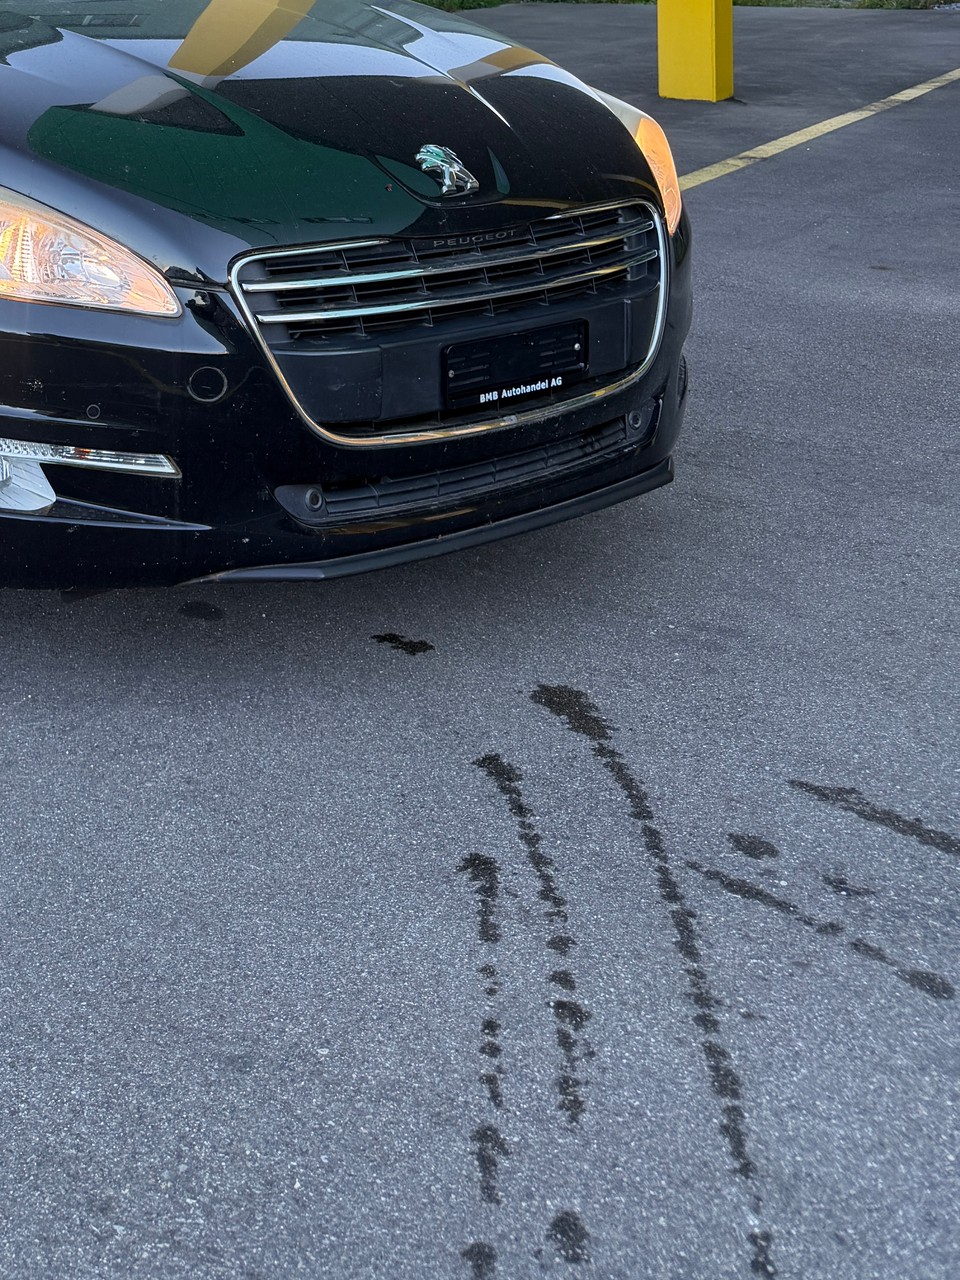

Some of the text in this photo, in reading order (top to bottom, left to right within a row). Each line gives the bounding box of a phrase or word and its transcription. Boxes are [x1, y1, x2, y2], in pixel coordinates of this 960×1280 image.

[433, 229, 517, 247] PEUGEOT
[480, 376, 562, 403] BMB Autohandel AG
